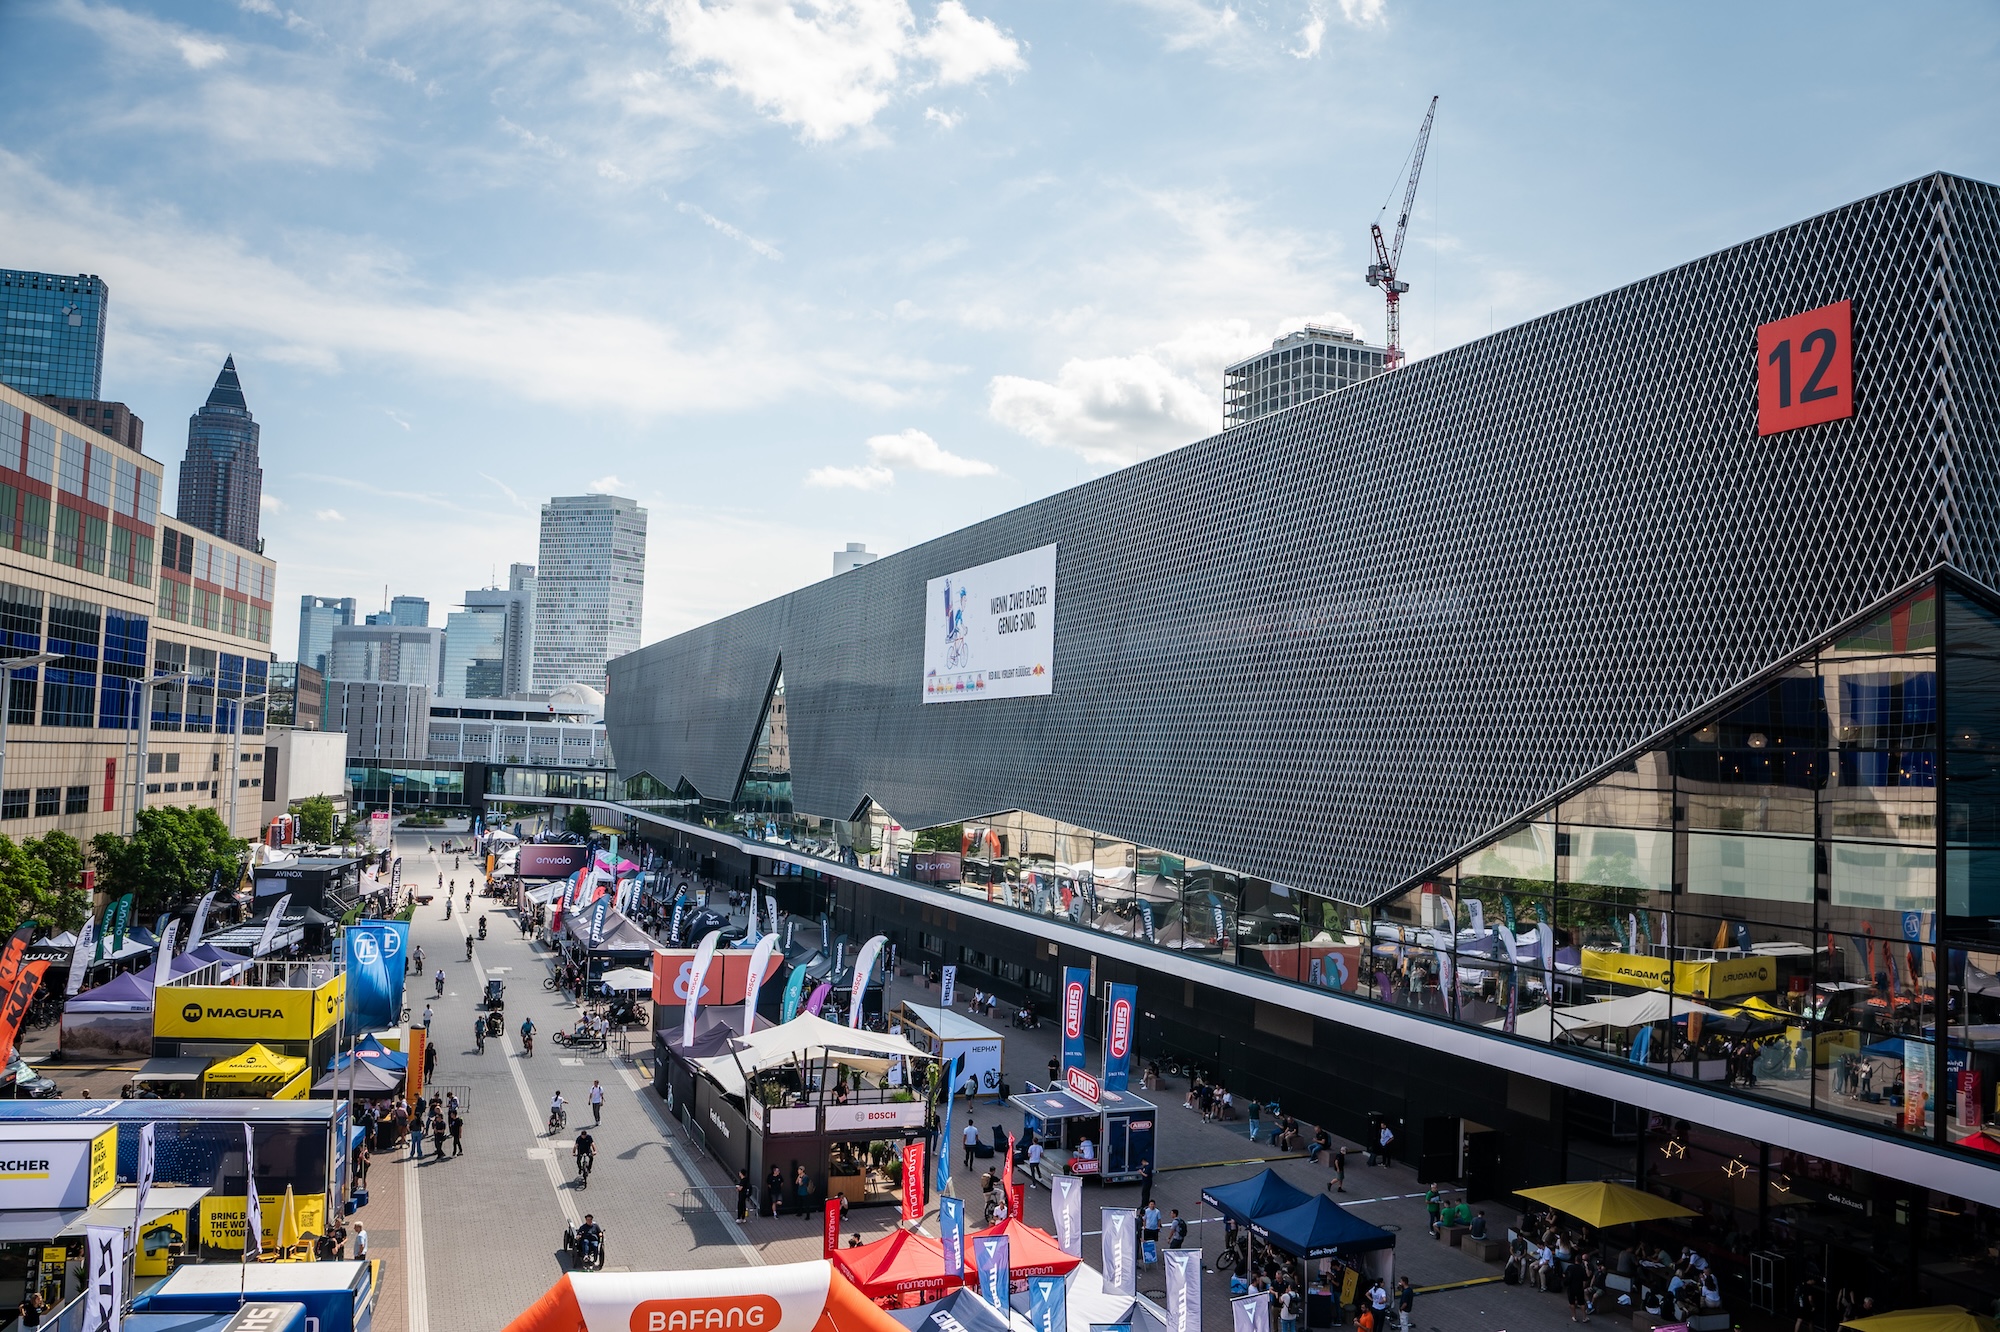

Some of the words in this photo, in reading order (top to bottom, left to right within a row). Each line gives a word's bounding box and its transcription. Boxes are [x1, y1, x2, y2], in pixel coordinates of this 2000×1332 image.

[1769, 328, 1838, 409] 12
[990, 595, 1008, 615] WENN
[1008, 591, 1024, 611] ZWEI
[1025, 585, 1047, 607] RÄDER
[997, 614, 1018, 635] GENUG
[1020, 612, 1036, 631] SIND.
[106, 762, 115, 780] 10
[536, 856, 572, 865] enviolo
[563, 879, 575, 910] pinion
[631, 880, 642, 910] pinion
[116, 900, 129, 936] owuru
[202, 897, 211, 918] MAHLE
[277, 900, 287, 920] MAHLE
[592, 904, 605, 942] pinion
[671, 904, 682, 942] pinion
[83, 924, 92, 948] MAHLE
[167, 926, 176, 951] MAHLE
[785, 921, 793, 949] Panasonic
[356, 938, 376, 958] ZF
[835, 942, 843, 973] Panasonic
[690, 972, 699, 996] BOSCH
[747, 973, 757, 997] BOSCH
[853, 972, 863, 995] BOSCH
[944, 972, 952, 1001] HEPHA
[7, 970, 39, 1029] KTM
[1069, 989, 1080, 1032] ABUS
[207, 1008, 284, 1020] MAGURA
[1115, 1007, 1128, 1051] ABUS
[417, 1033, 425, 1090] REGISTRATION
[1069, 1072, 1095, 1097] ABUS
[868, 1111, 896, 1120] BOSCH
[93, 1150, 107, 1164] WASH.
[94, 1139, 105, 1152] RIDE.
[93, 1163, 106, 1176] WOW.
[1076, 1162, 1099, 1171] ABUS
[92, 1175, 109, 1190] REPEAT.
[910, 1148, 918, 1218] momentum
[1828, 1193, 1841, 1203] Café
[1841, 1197, 1864, 1210] Zickzack
[211, 1212, 238, 1220] BRING
[211, 1221, 228, 1229] THE
[211, 1230, 222, 1238] TO
[1310, 1248, 1322, 1256] Selle
[1323, 1246, 1338, 1255] Royal
[1010, 1266, 1053, 1277] momentum
[896, 1278, 944, 1290] momentum
[649, 1307, 764, 1331] BAFANG
